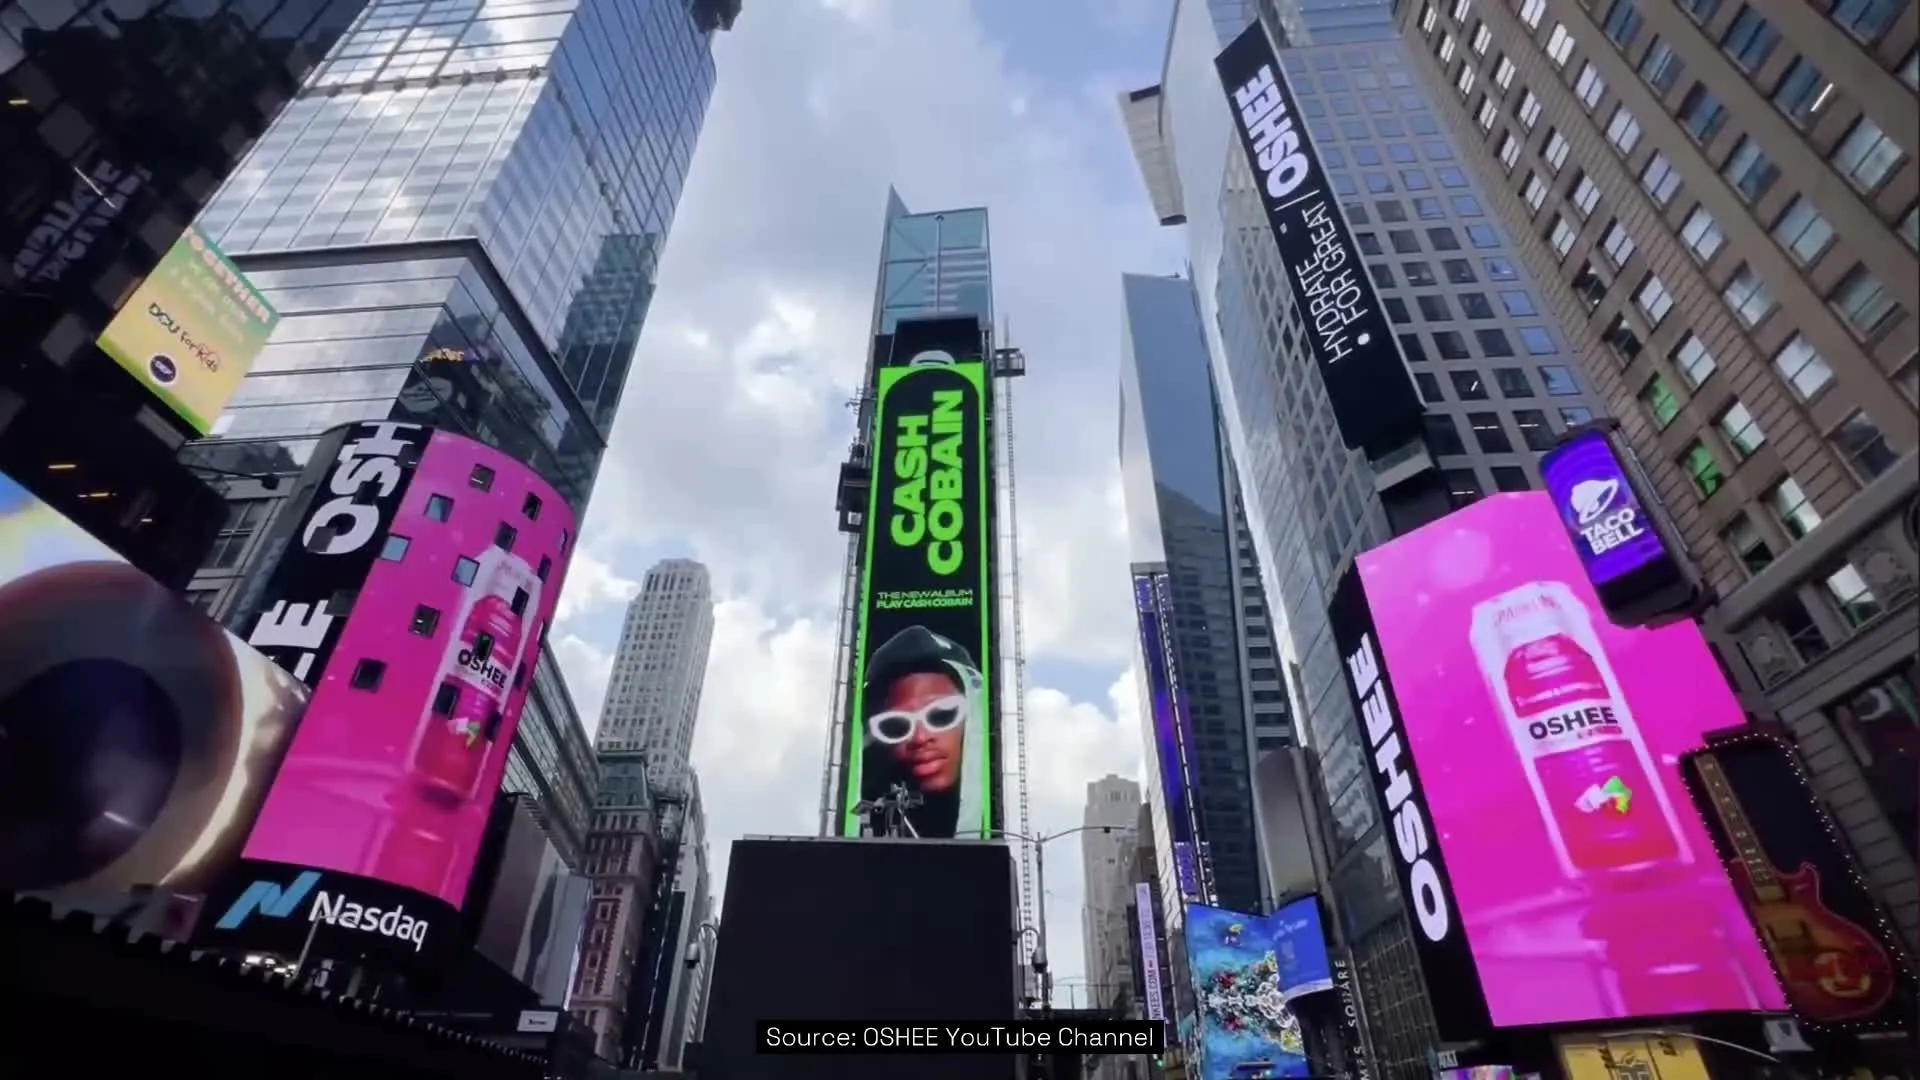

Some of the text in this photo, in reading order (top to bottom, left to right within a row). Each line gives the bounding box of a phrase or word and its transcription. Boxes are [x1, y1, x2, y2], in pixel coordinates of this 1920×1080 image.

[1233, 63, 1309, 199] OSHEE
[1302, 200, 1368, 326] FOR GREAT
[1296, 250, 1352, 365] HYDRATE
[891, 415, 928, 546] CASH
[928, 390, 964, 575] COBAIN
[1580, 508, 1635, 541] TACO
[1591, 523, 1644, 555] BELL
[876, 598, 973, 609] PLAY CASH COBAIN
[878, 589, 973, 600] THE NEW ALBUM
[458, 649, 507, 688] OSHEE
[1528, 706, 1618, 740] OSHEE
[1346, 632, 1449, 942] OSHEE
[308, 890, 429, 952] Nasdaq
